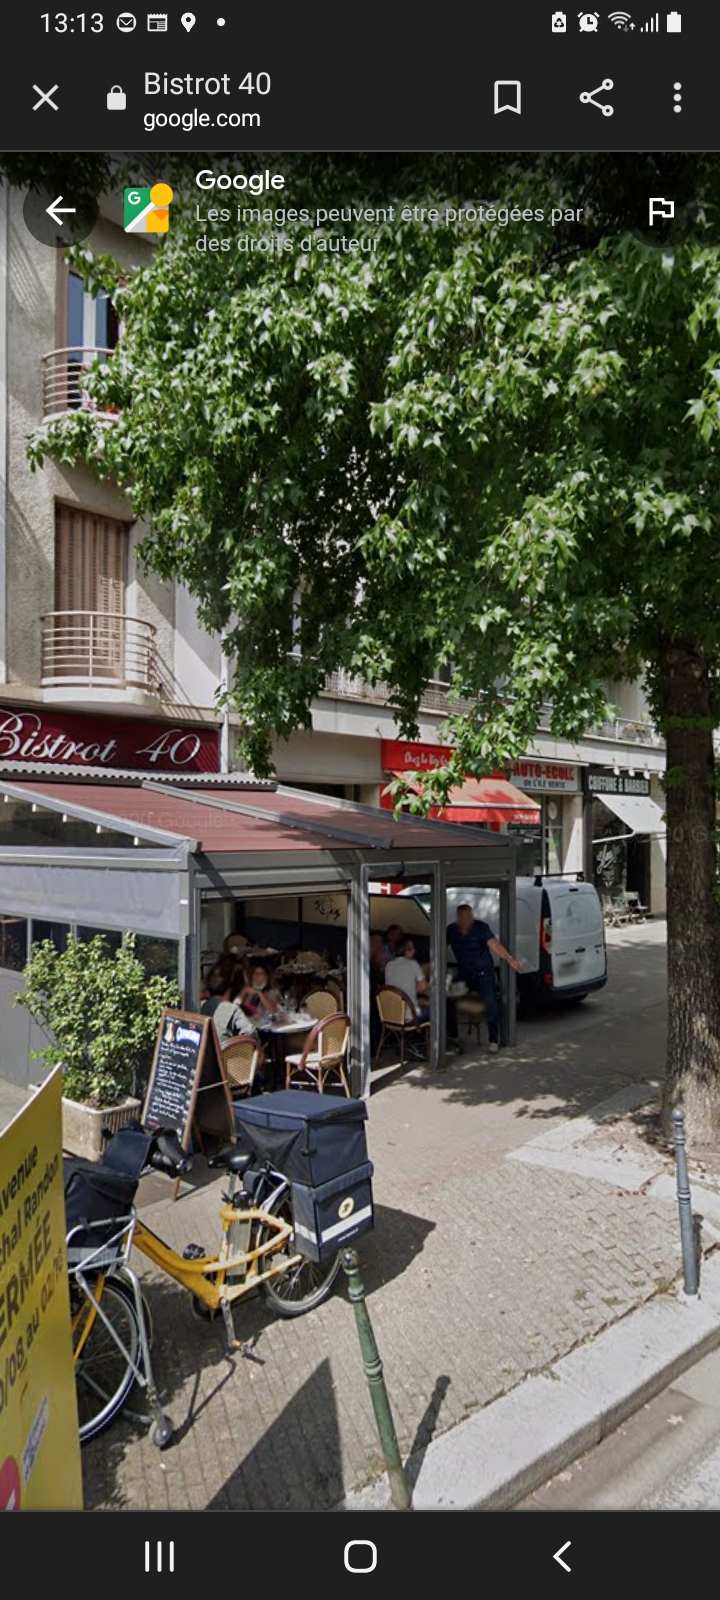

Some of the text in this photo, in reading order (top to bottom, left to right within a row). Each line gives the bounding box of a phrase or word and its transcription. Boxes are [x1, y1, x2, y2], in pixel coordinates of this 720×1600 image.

[0, 709, 202, 764] Bistrot 40
[588, 775, 618, 792] COIFFURE
[624, 778, 649, 795] BARBIER
